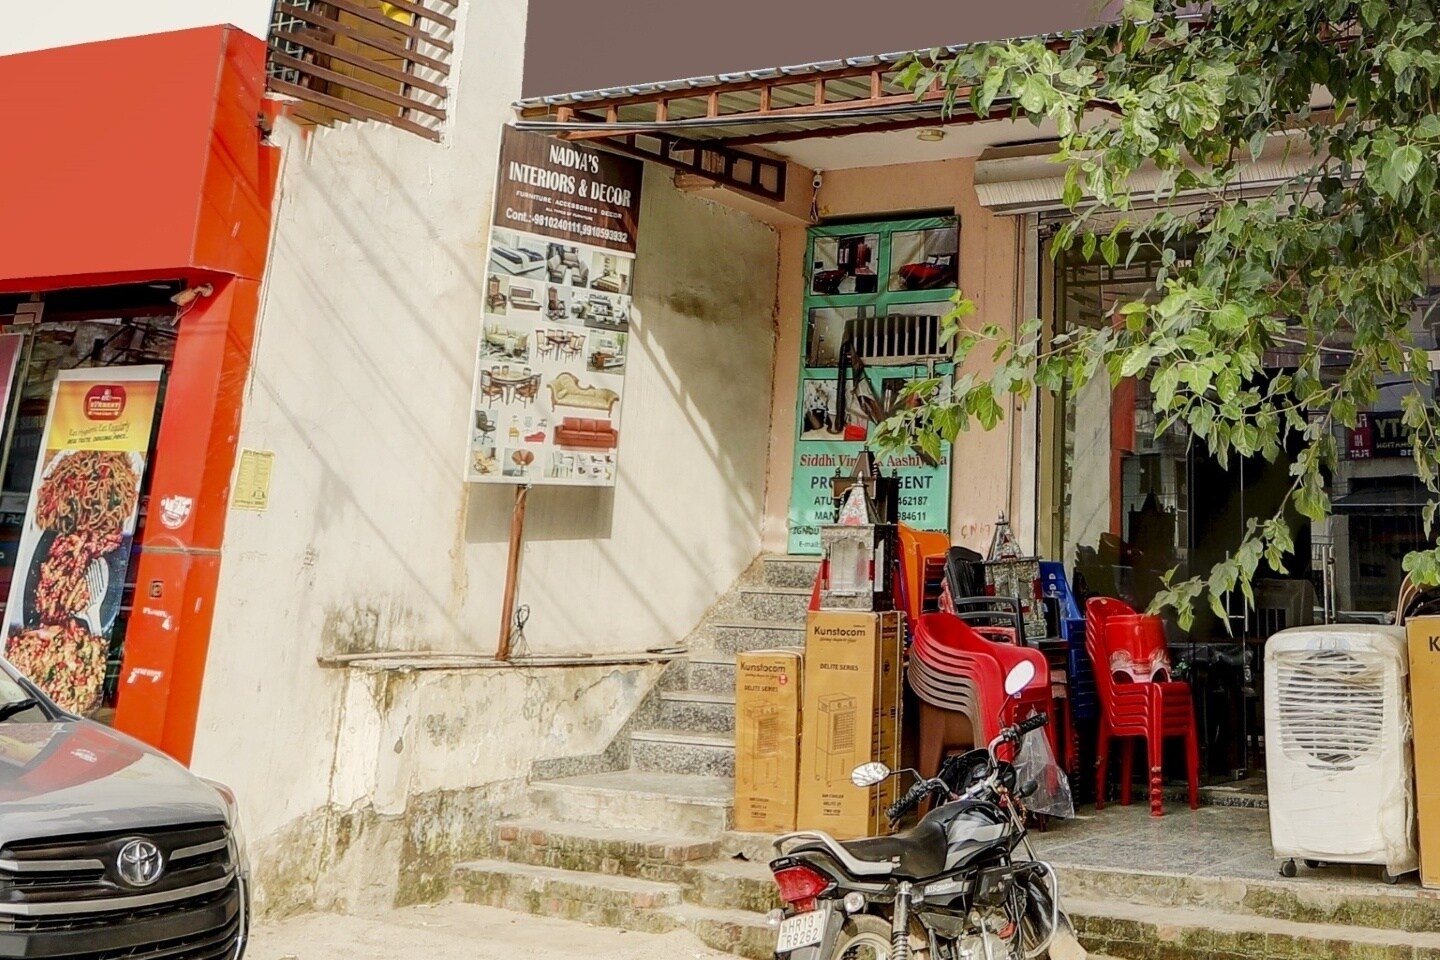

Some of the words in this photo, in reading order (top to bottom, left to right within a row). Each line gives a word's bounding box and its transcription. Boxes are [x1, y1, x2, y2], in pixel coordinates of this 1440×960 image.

[549, 144, 599, 174] NADYA'S
[509, 161, 576, 195] INTERIORS
[578, 179, 588, 198] &
[591, 182, 631, 207] DECOR
[516, 190, 552, 204] FURNITURE
[555, 199, 598, 214] ACCESSORIES
[600, 209, 622, 219] DECOR
[800, 453, 835, 467] Siddhi
[814, 626, 866, 638] Kunstocom
[740, 661, 786, 674] Kunstocom
[840, 664, 859, 672] SERIES
